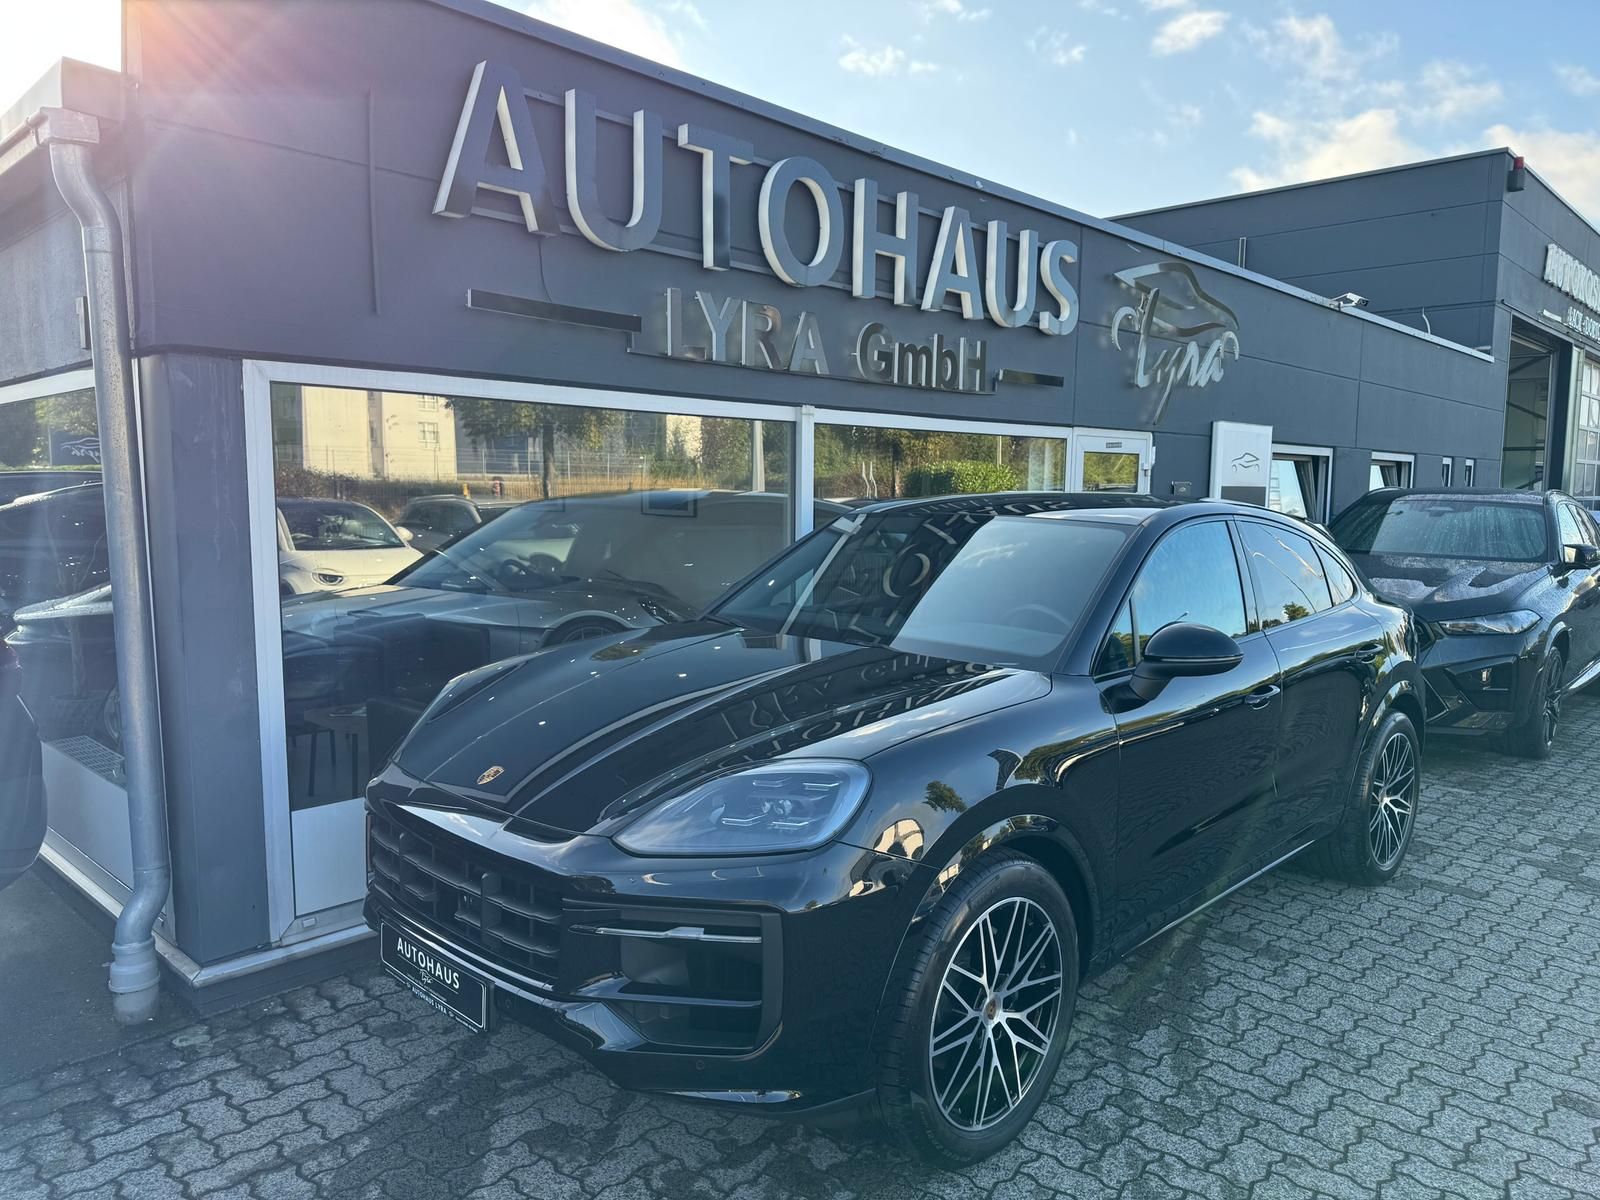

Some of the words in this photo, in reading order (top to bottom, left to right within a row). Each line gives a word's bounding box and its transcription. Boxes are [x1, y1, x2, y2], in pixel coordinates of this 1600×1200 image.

[432, 59, 1081, 336] AUTOHAUS
[1544, 243, 1600, 314] AUTOKOS
[665, 287, 830, 375] LYRA
[854, 321, 988, 392] GmbH
[397, 937, 460, 989] AUTOHAUS
